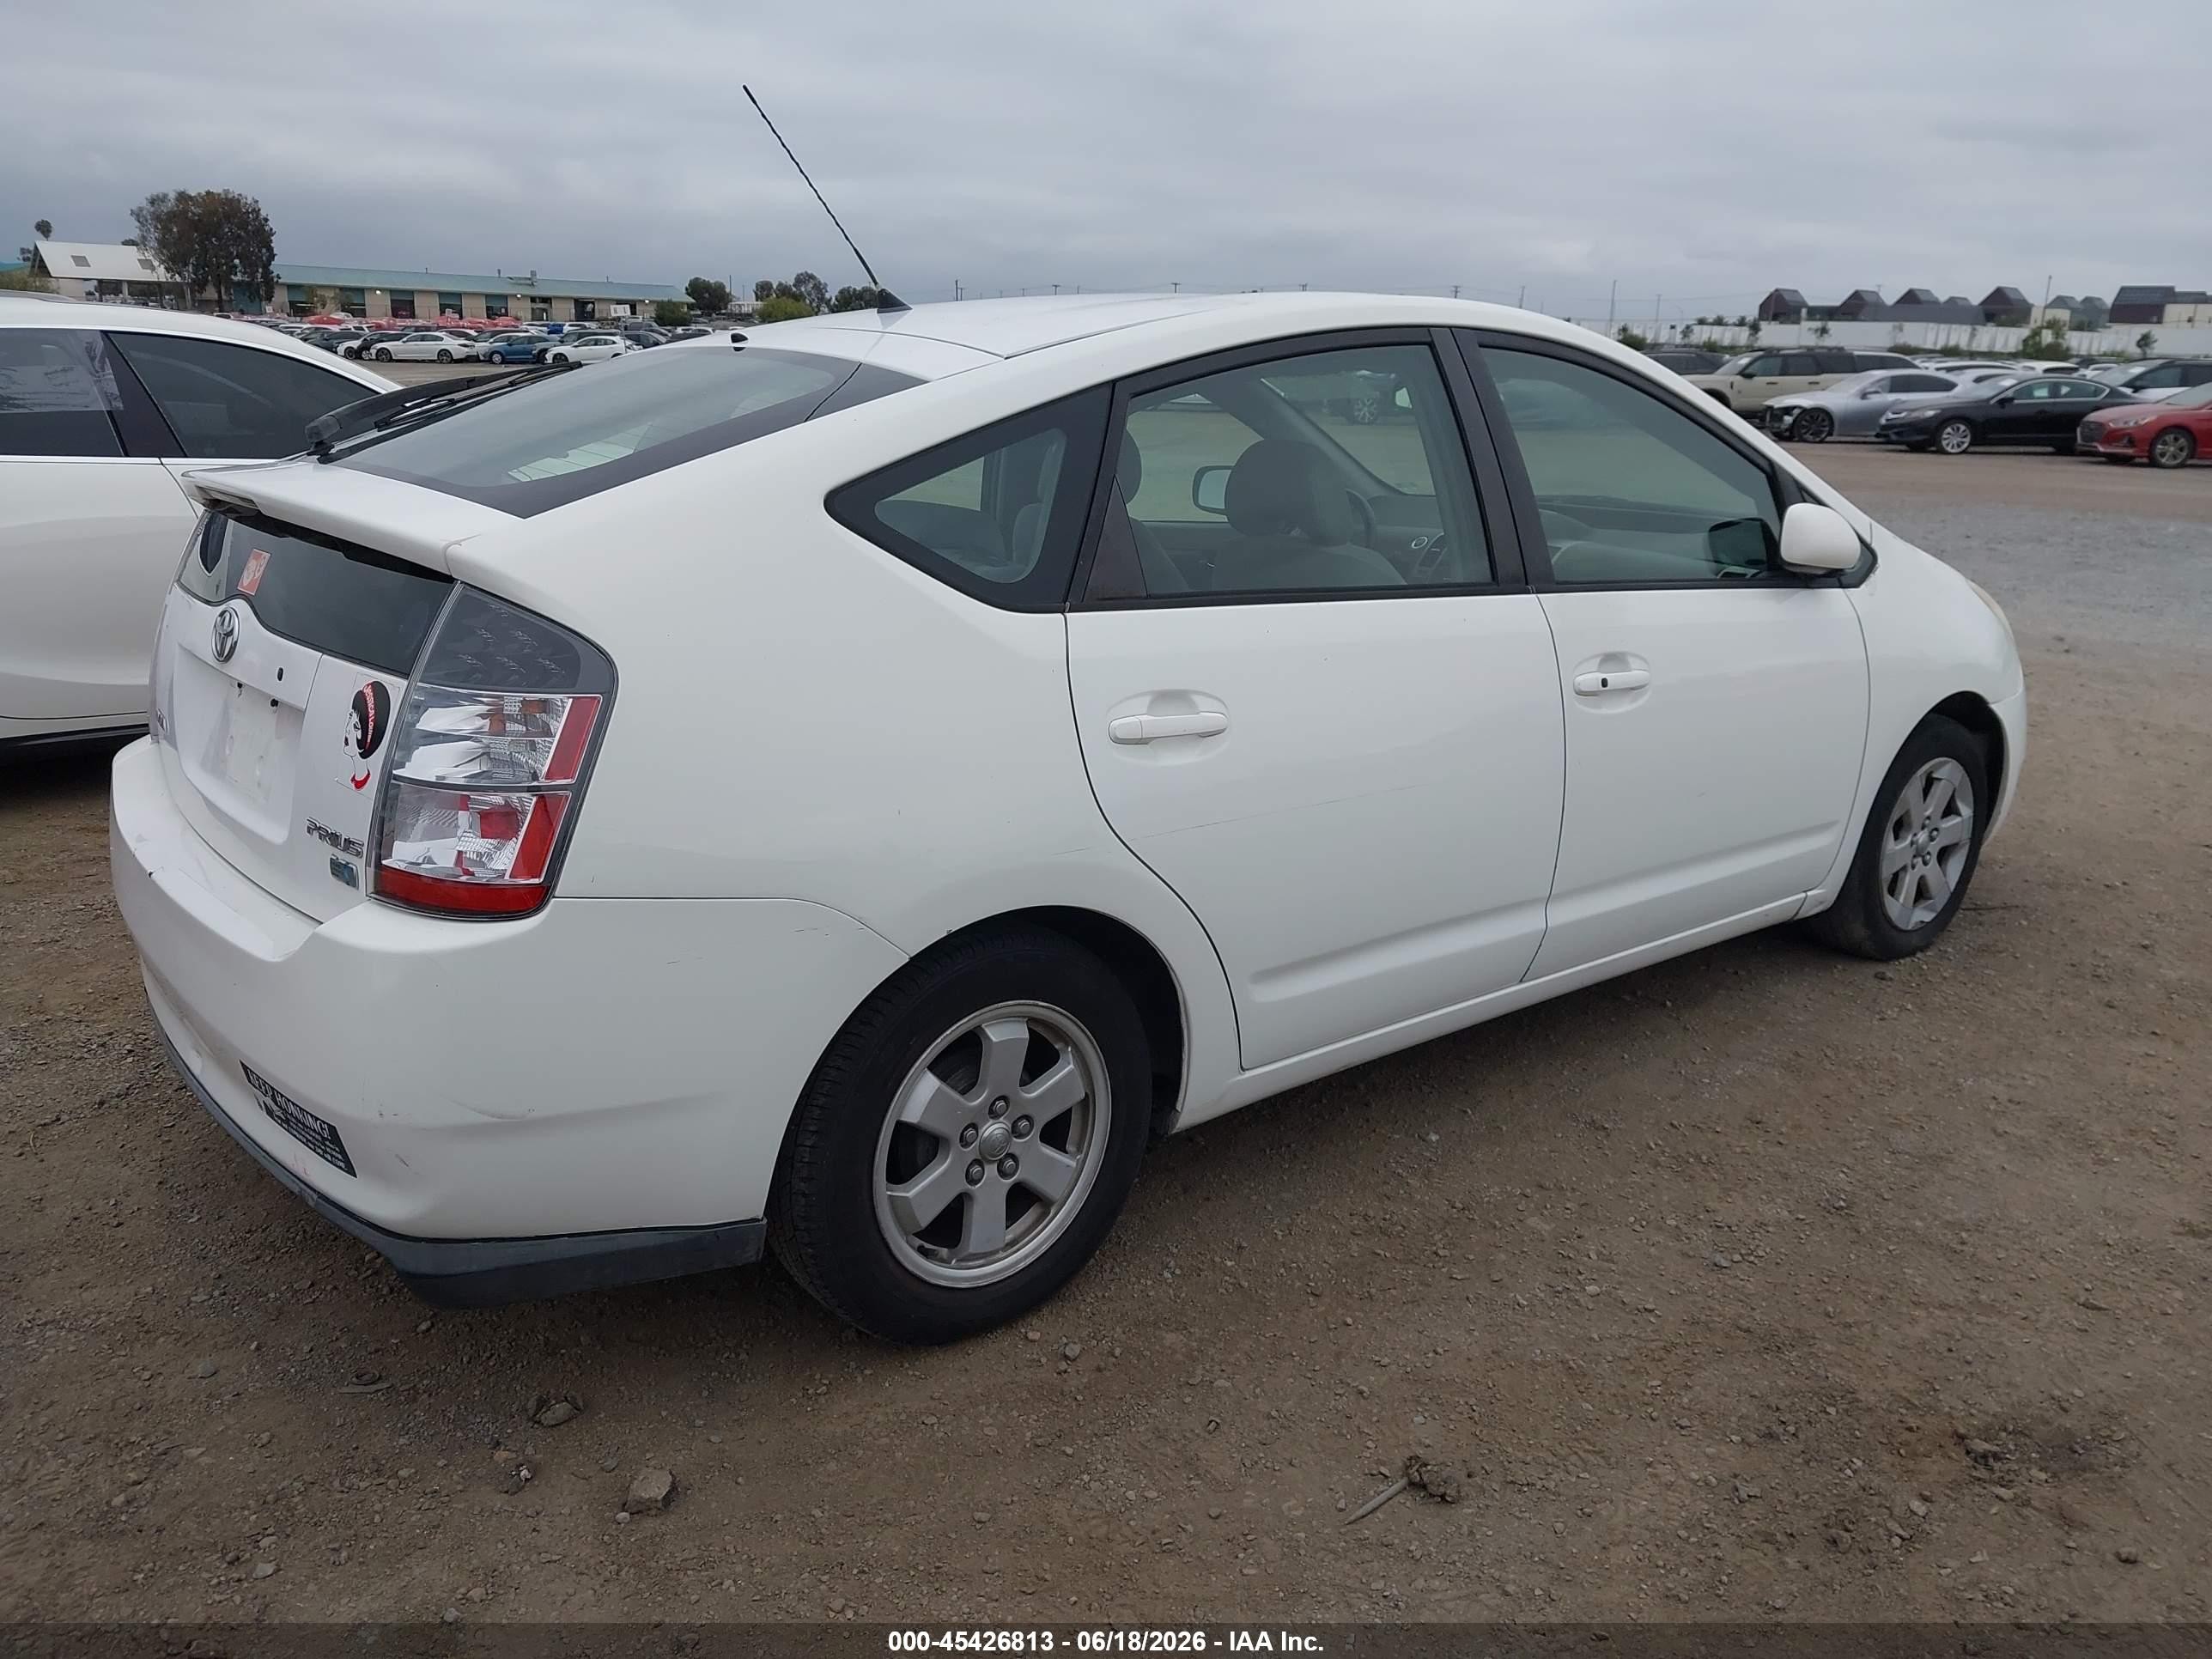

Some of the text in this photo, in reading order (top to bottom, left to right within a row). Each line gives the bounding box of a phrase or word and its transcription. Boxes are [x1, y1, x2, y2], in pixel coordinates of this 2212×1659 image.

[307, 817, 364, 859] PRIUS
[247, 1068, 331, 1140] KEEP HONKING!
